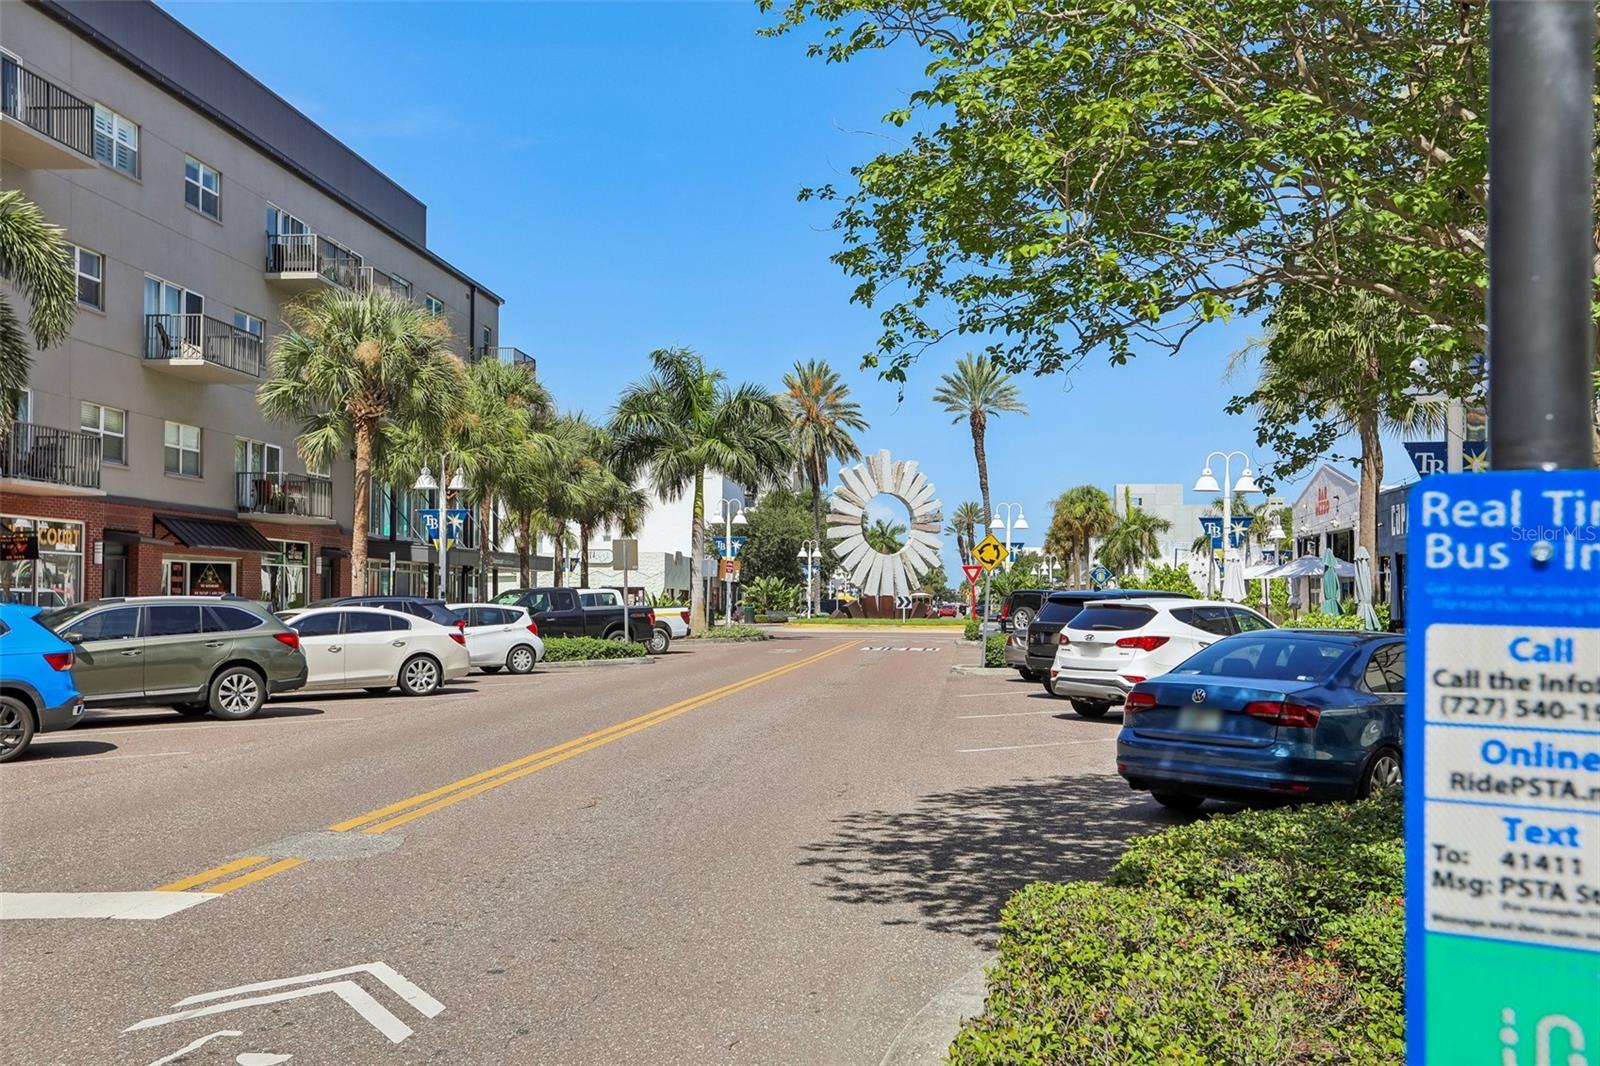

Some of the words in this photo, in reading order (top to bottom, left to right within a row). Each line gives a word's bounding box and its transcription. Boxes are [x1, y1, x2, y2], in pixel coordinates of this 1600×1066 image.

[422, 514, 439, 530] TB
[1422, 489, 1522, 527] Real
[1541, 489, 1600, 526] Ti
[1204, 522, 1222, 538] TB
[1425, 532, 1510, 570] Bus
[1509, 636, 1573, 663] Call
[1433, 668, 1480, 688] Call
[1489, 670, 1531, 691] the
[1440, 695, 1506, 719] (727)
[1481, 739, 1600, 772] Online
[1502, 816, 1579, 848] Text
[1433, 843, 1469, 865] To:
[1502, 852, 1581, 876] 41411
[1432, 869, 1492, 897] Msg:
[1501, 876, 1567, 902] PSTA
